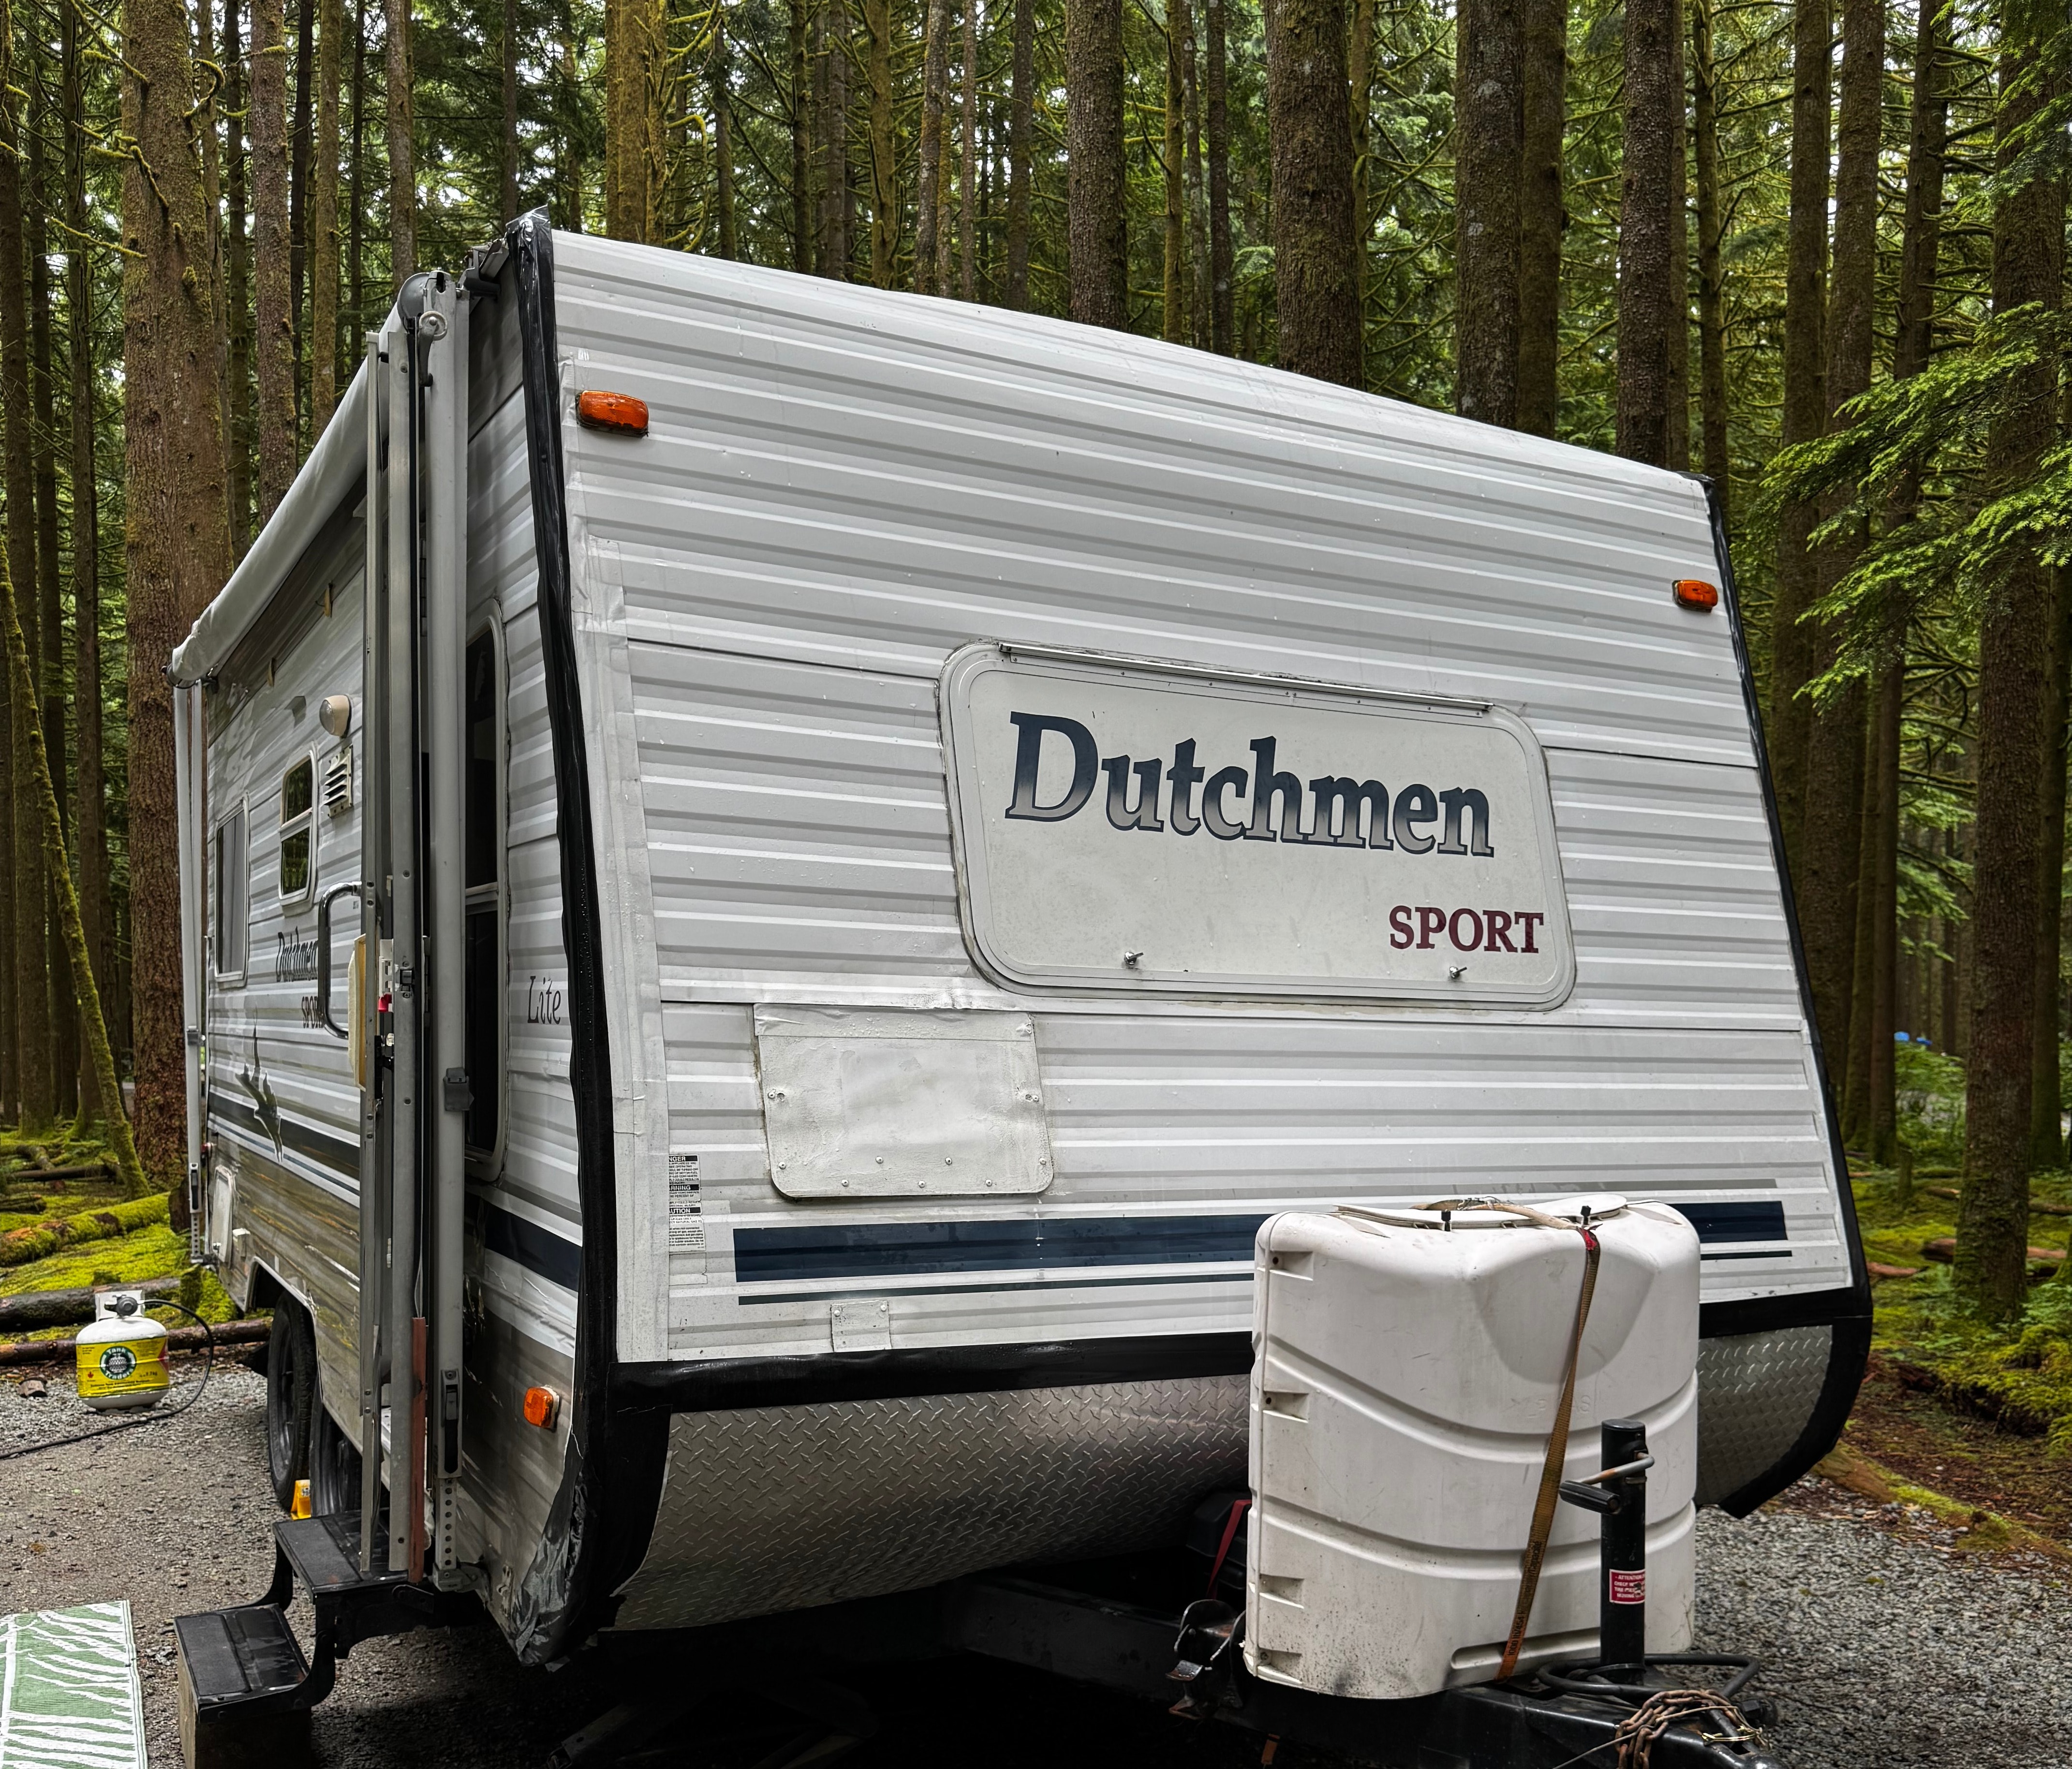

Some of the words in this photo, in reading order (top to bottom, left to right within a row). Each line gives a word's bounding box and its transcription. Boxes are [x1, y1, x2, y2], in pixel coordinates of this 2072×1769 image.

[1005, 711, 1494, 858] Dutchmen
[1389, 905, 1544, 953] SPORT
[276, 926, 318, 982] Dutchmen
[302, 996, 324, 1028] SPOR
[528, 976, 561, 1024] Lite
